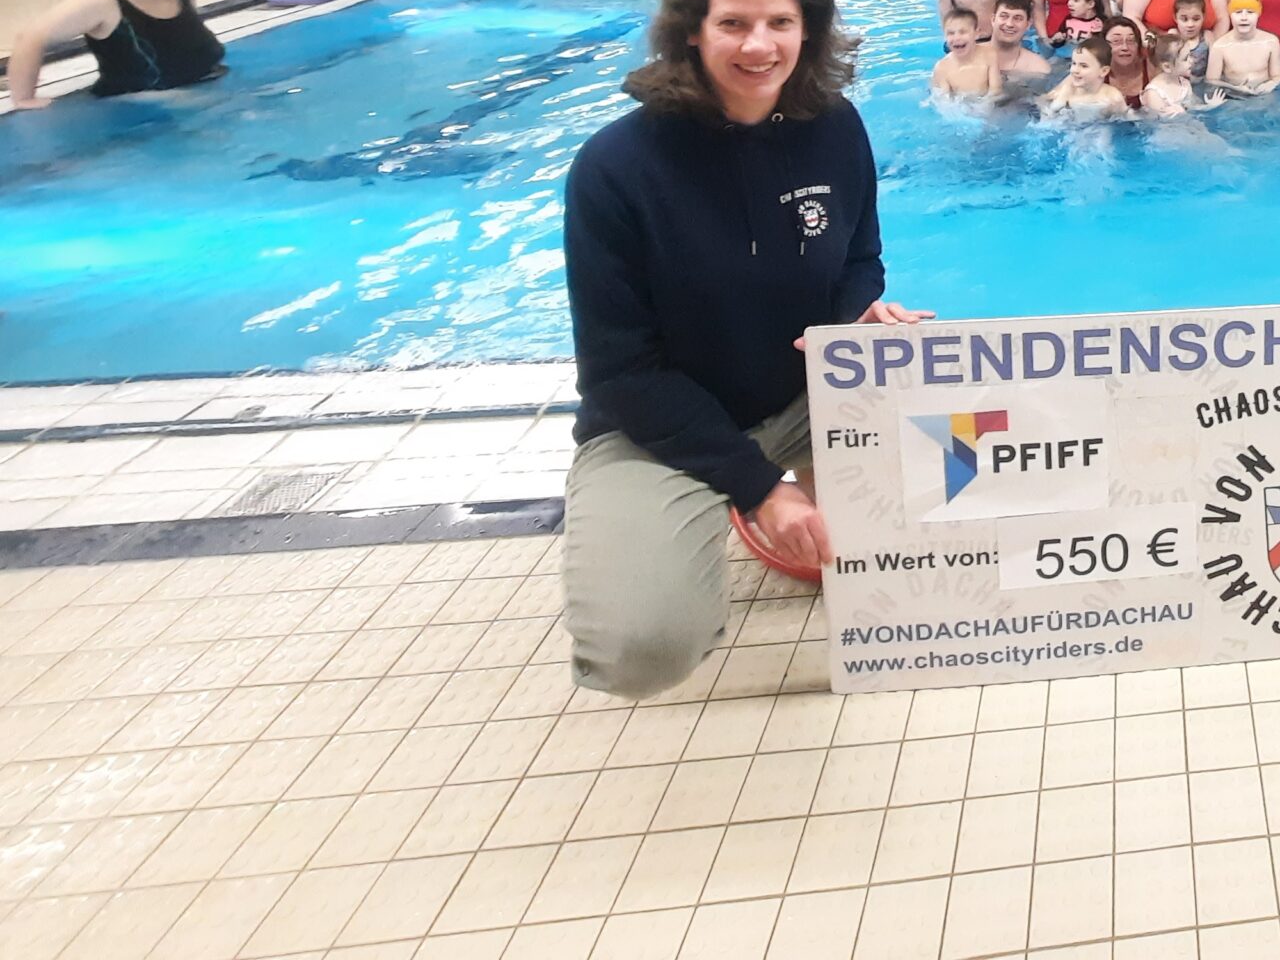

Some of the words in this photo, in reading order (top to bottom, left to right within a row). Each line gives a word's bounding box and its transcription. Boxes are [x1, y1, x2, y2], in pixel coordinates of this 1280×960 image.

[826, 429, 880, 449] Für:
[992, 438, 1104, 474] PFIFF
[1200, 444, 1276, 524] VON
[836, 555, 866, 575] Im
[875, 550, 935, 571] Wert
[943, 548, 999, 568] von:
[1035, 533, 1129, 579] 550
[1146, 527, 1179, 568] €
[841, 602, 1194, 647] #VONDACHAUFÜRDACHAU
[844, 636, 1144, 674] www.chaoscityriders.de
